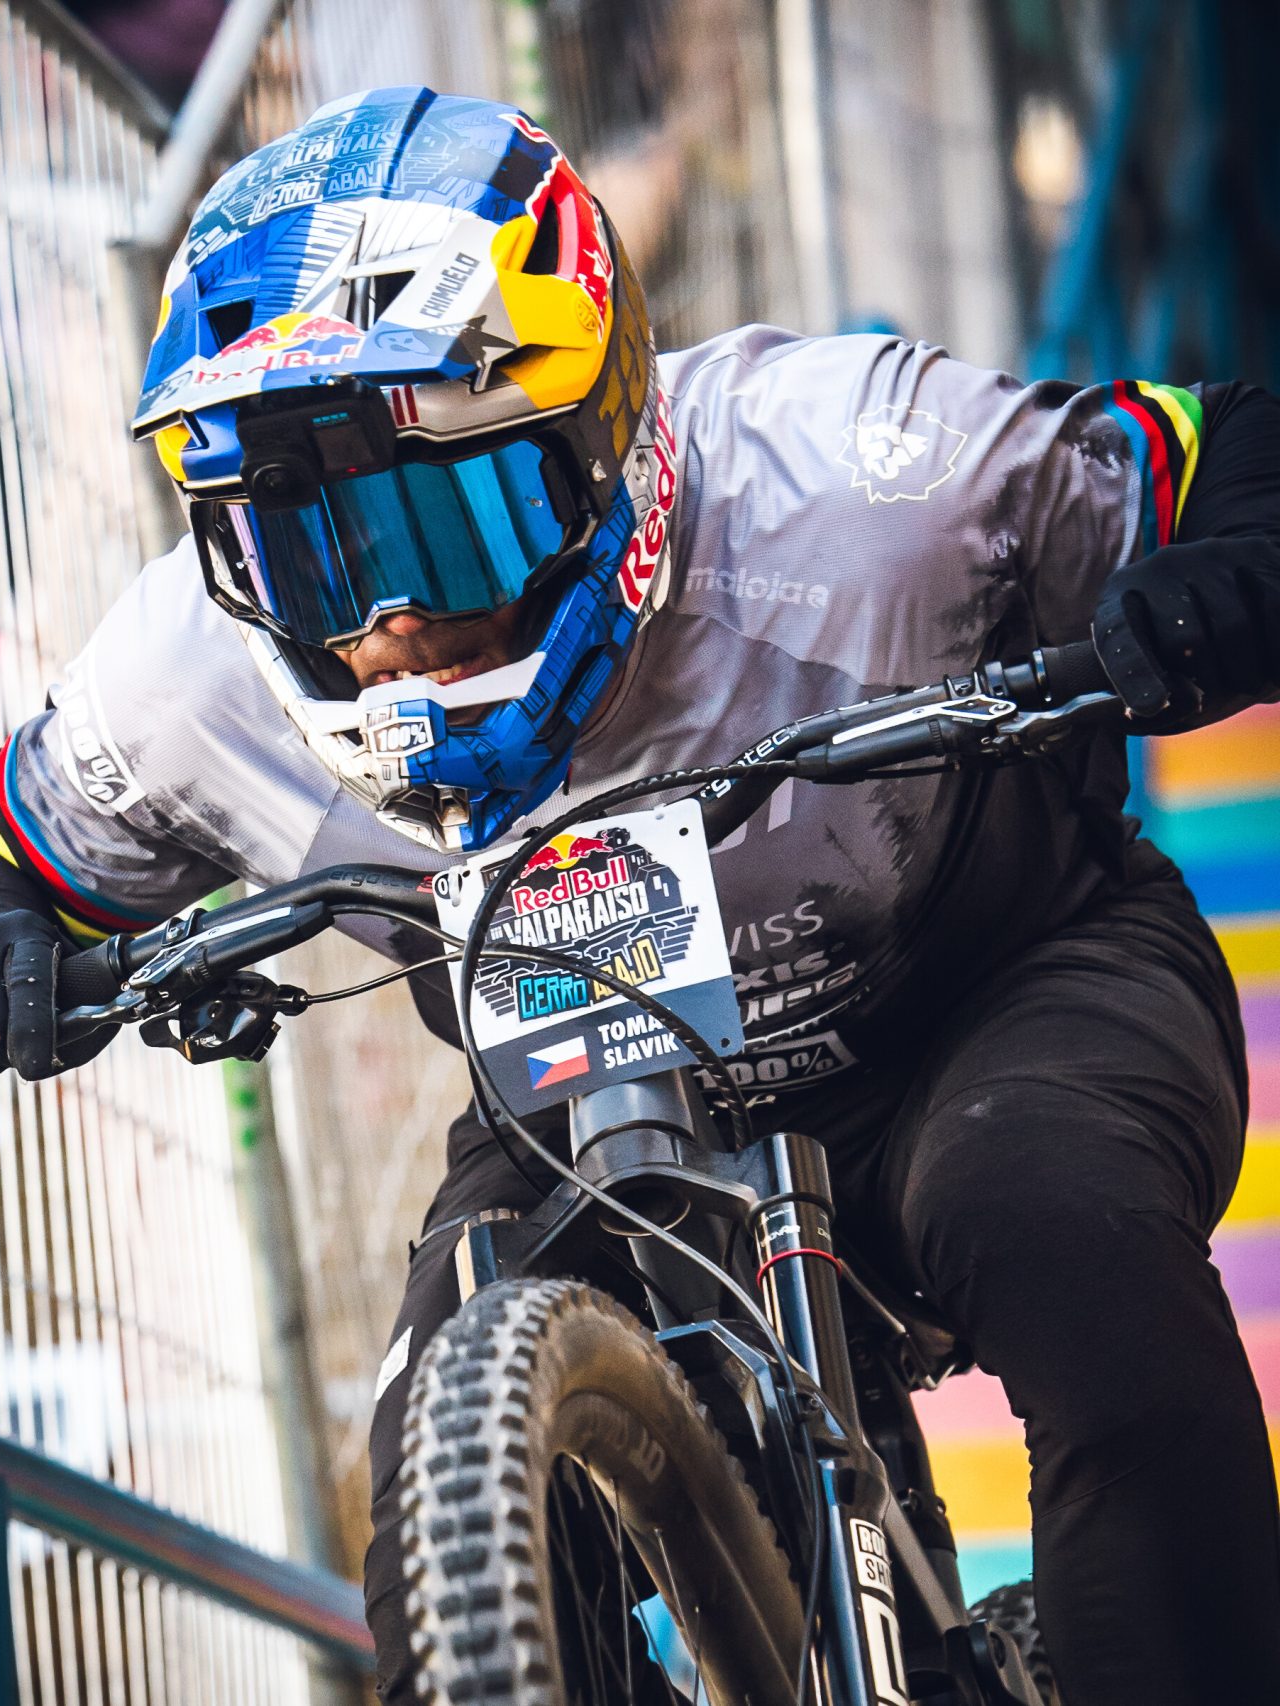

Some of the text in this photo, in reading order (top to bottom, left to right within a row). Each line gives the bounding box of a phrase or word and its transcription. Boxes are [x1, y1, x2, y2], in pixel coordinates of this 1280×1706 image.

[258, 180, 320, 216] CERRO
[419, 251, 481, 319] CHIMUELO
[377, 722, 429, 752] 100%
[514, 856, 629, 915] Red Bull
[501, 881, 650, 945] VALPARAISO
[520, 938, 661, 1019] CERRO AAJO
[598, 1007, 671, 1044] TOMA
[603, 1031, 680, 1070] SLAVIK
[693, 1046, 835, 1090] 100%
